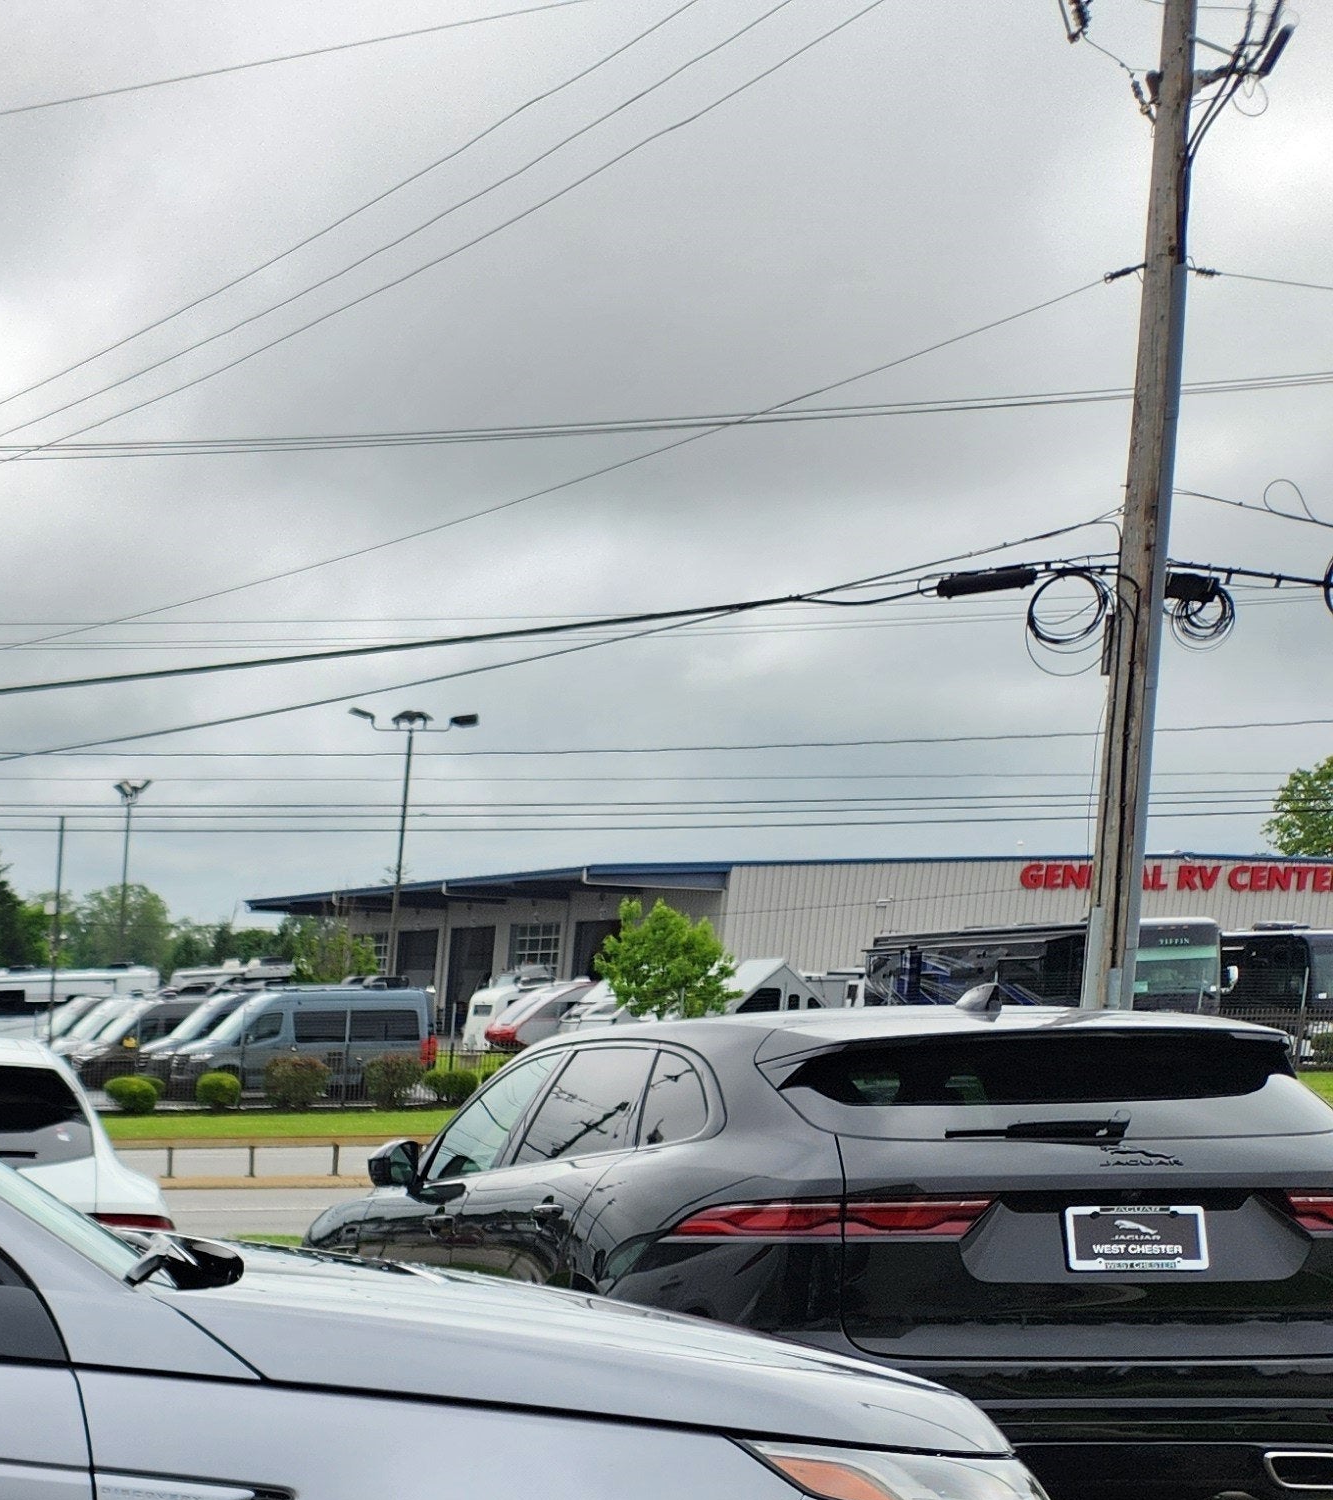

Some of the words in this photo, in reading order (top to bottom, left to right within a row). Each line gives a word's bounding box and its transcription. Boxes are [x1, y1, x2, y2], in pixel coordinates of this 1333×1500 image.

[1019, 863, 1168, 891] GENL
[1177, 865, 1221, 891] RV
[1228, 865, 1333, 892] CENTE
[1093, 1244, 1126, 1254] WEST
[1128, 1244, 1183, 1254] CHESTER
[101, 1486, 203, 1500] DISCOVERY
